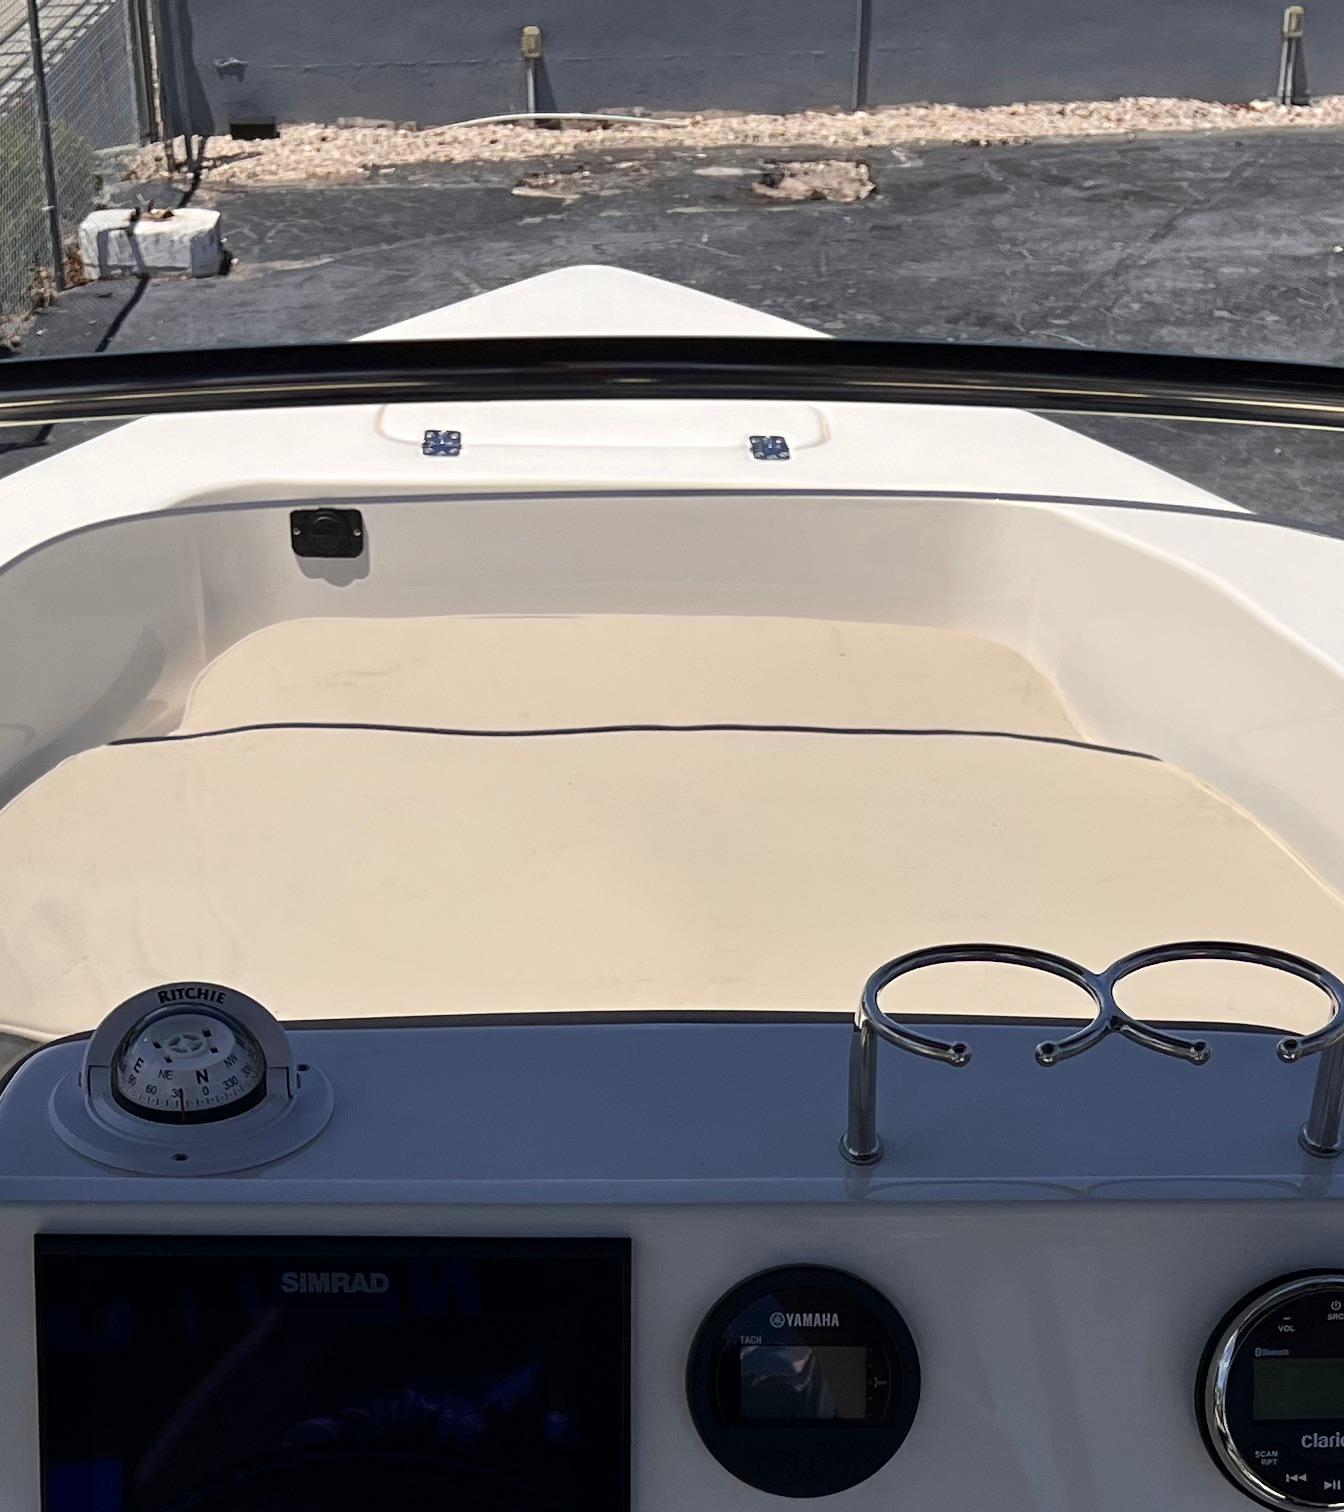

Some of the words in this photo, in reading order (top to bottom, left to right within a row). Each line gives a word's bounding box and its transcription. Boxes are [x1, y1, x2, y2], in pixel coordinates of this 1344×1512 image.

[157, 986, 227, 1005] RITCHIE
[133, 1056, 145, 1074] E
[158, 1068, 174, 1081] NE
[195, 1068, 210, 1085] N
[145, 1084, 158, 1095] 60
[201, 1086, 210, 1097] 0
[280, 1271, 390, 1294] SIMRAD
[785, 1312, 841, 1328] YAMAHA
[1277, 1324, 1297, 1333] VOL
[739, 1334, 763, 1345] TACH
